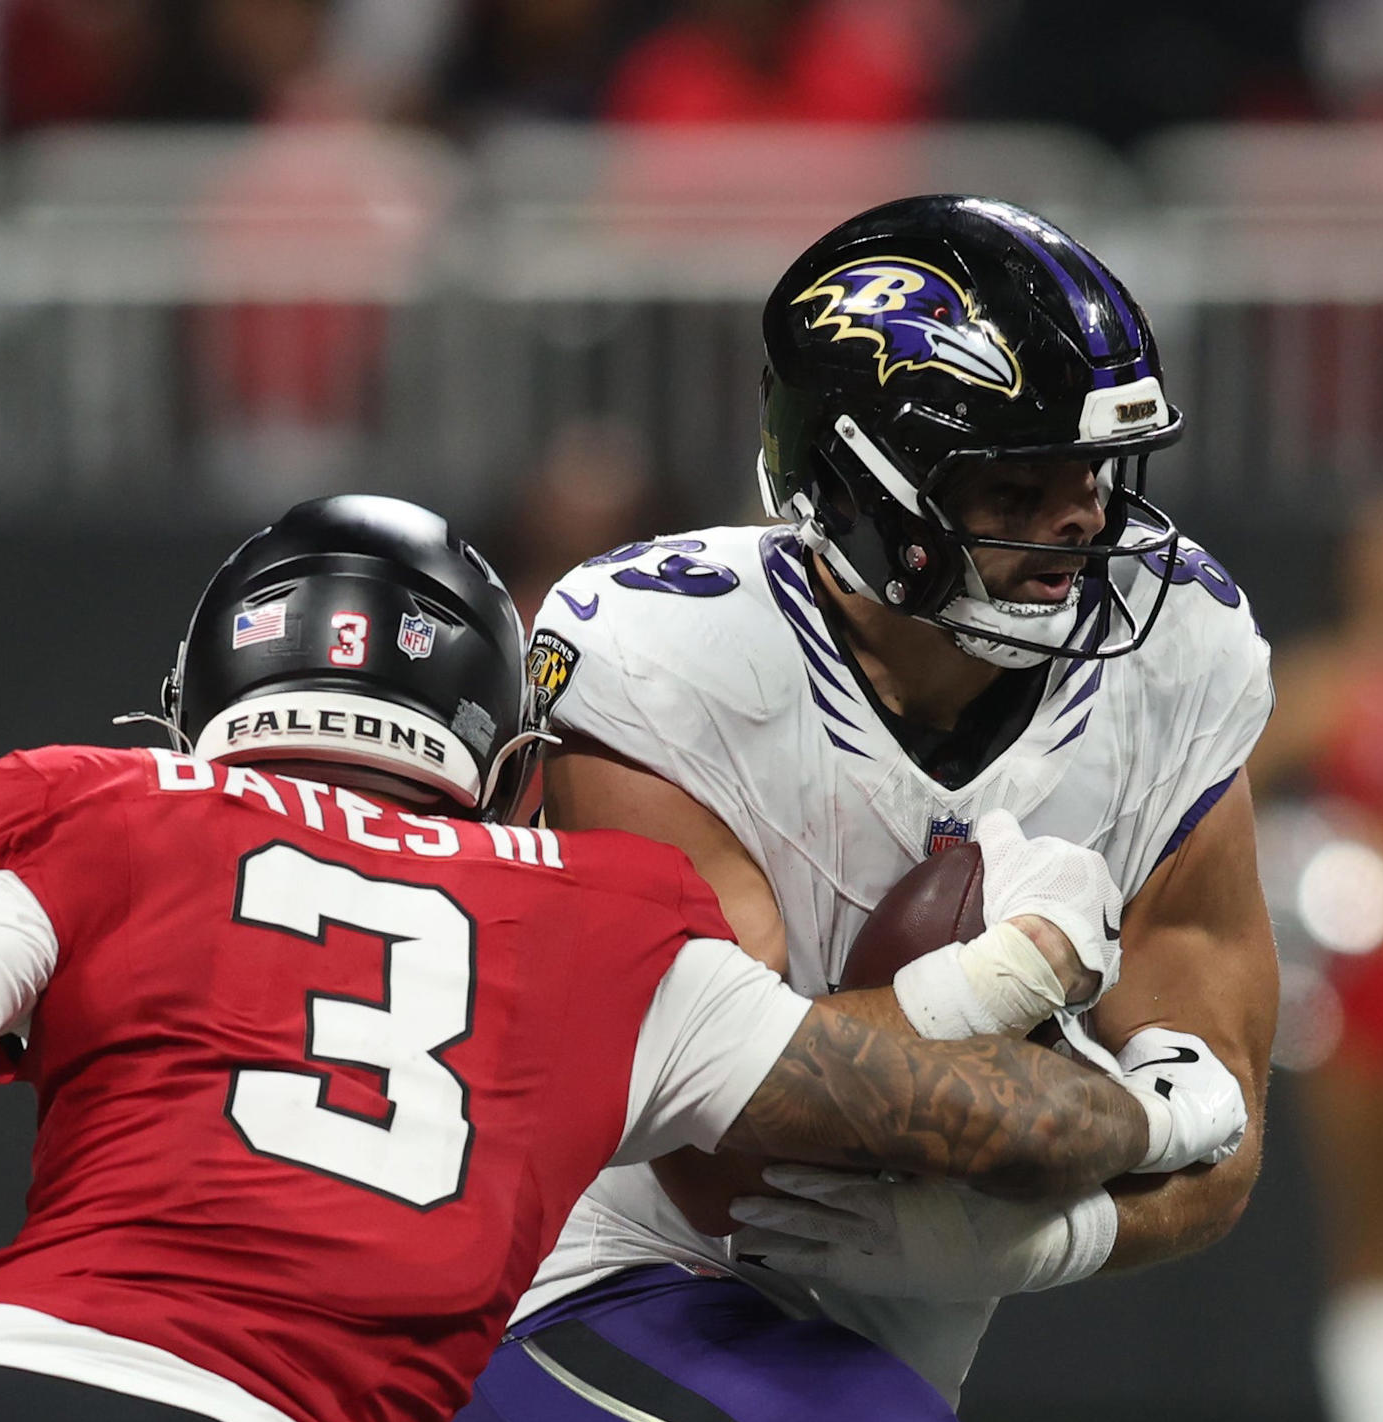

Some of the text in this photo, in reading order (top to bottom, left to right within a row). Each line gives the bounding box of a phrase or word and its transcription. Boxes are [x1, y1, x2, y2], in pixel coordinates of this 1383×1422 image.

[328, 610, 371, 668] 3
[403, 630, 427, 652] NFL
[536, 634, 574, 662] RAVENS
[226, 709, 446, 766] FALCONS
[147, 747, 564, 869] BATES III
[223, 838, 477, 1213] 3
